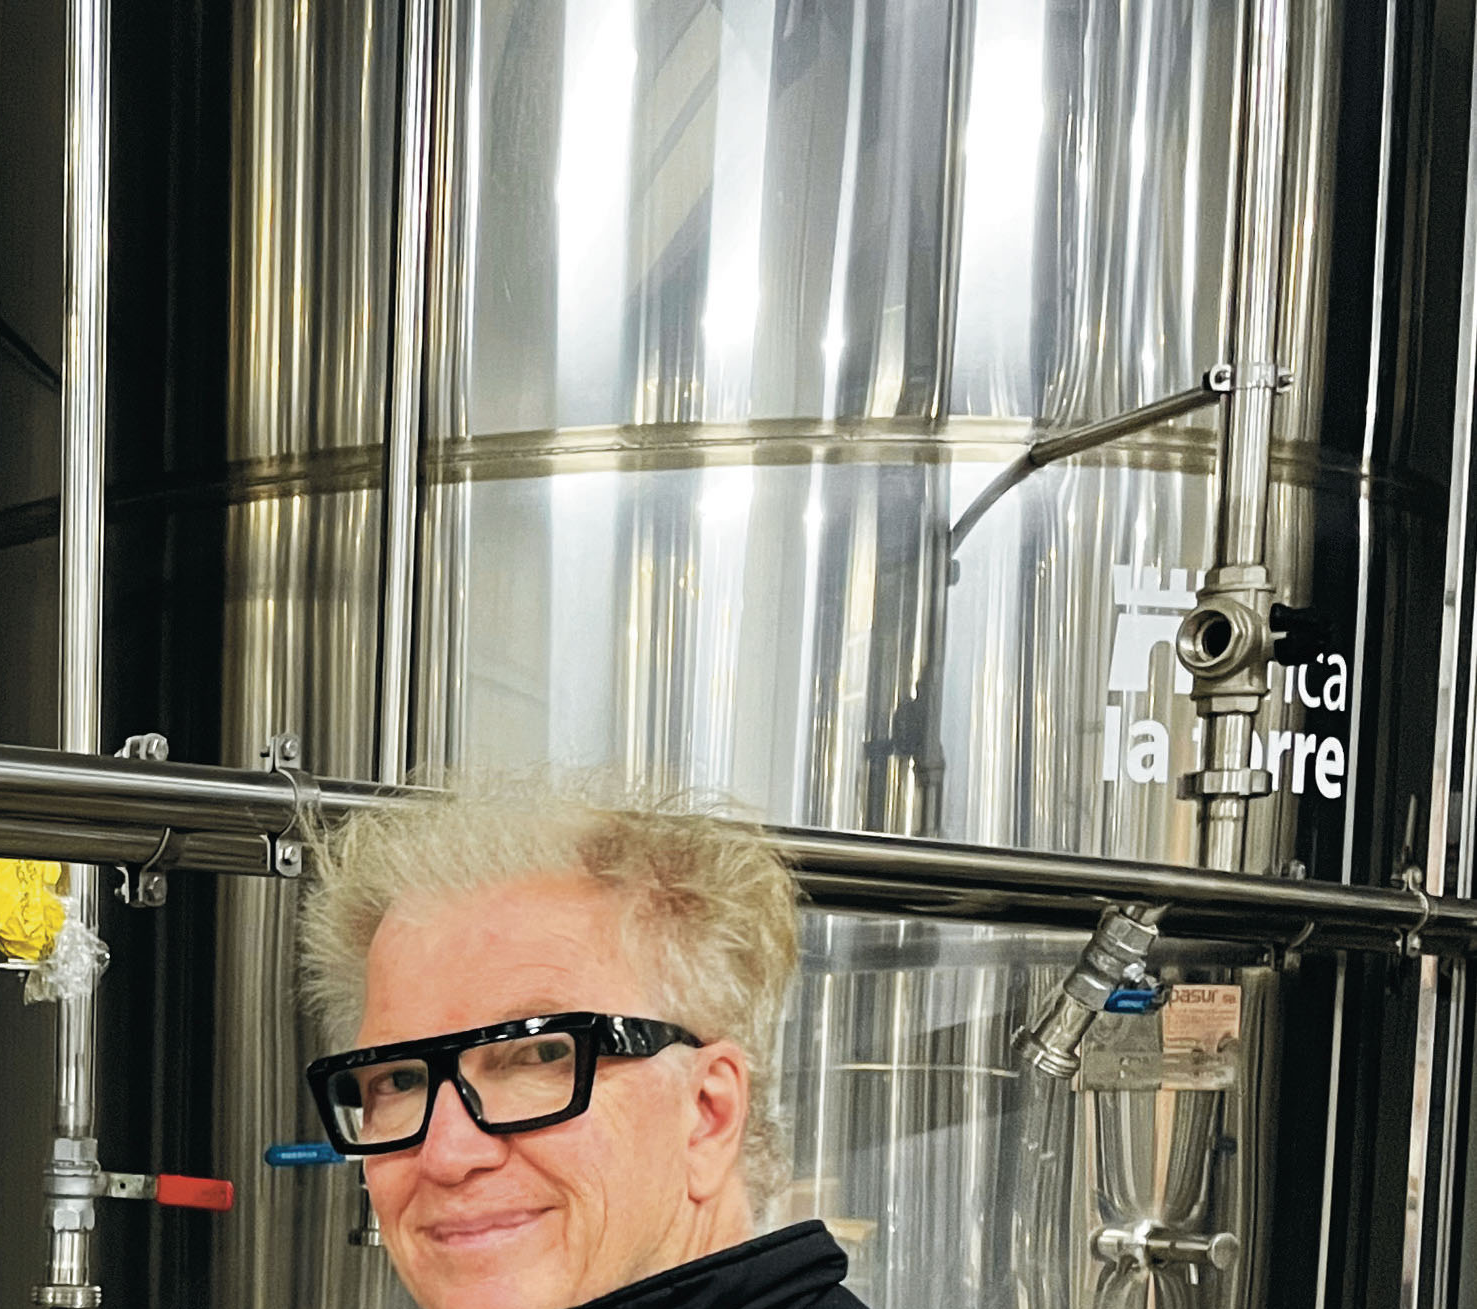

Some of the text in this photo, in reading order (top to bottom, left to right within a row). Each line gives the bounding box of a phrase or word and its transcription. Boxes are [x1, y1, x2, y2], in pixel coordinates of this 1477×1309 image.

[1267, 652, 1347, 712] nca
[1103, 705, 1345, 800] la rre
